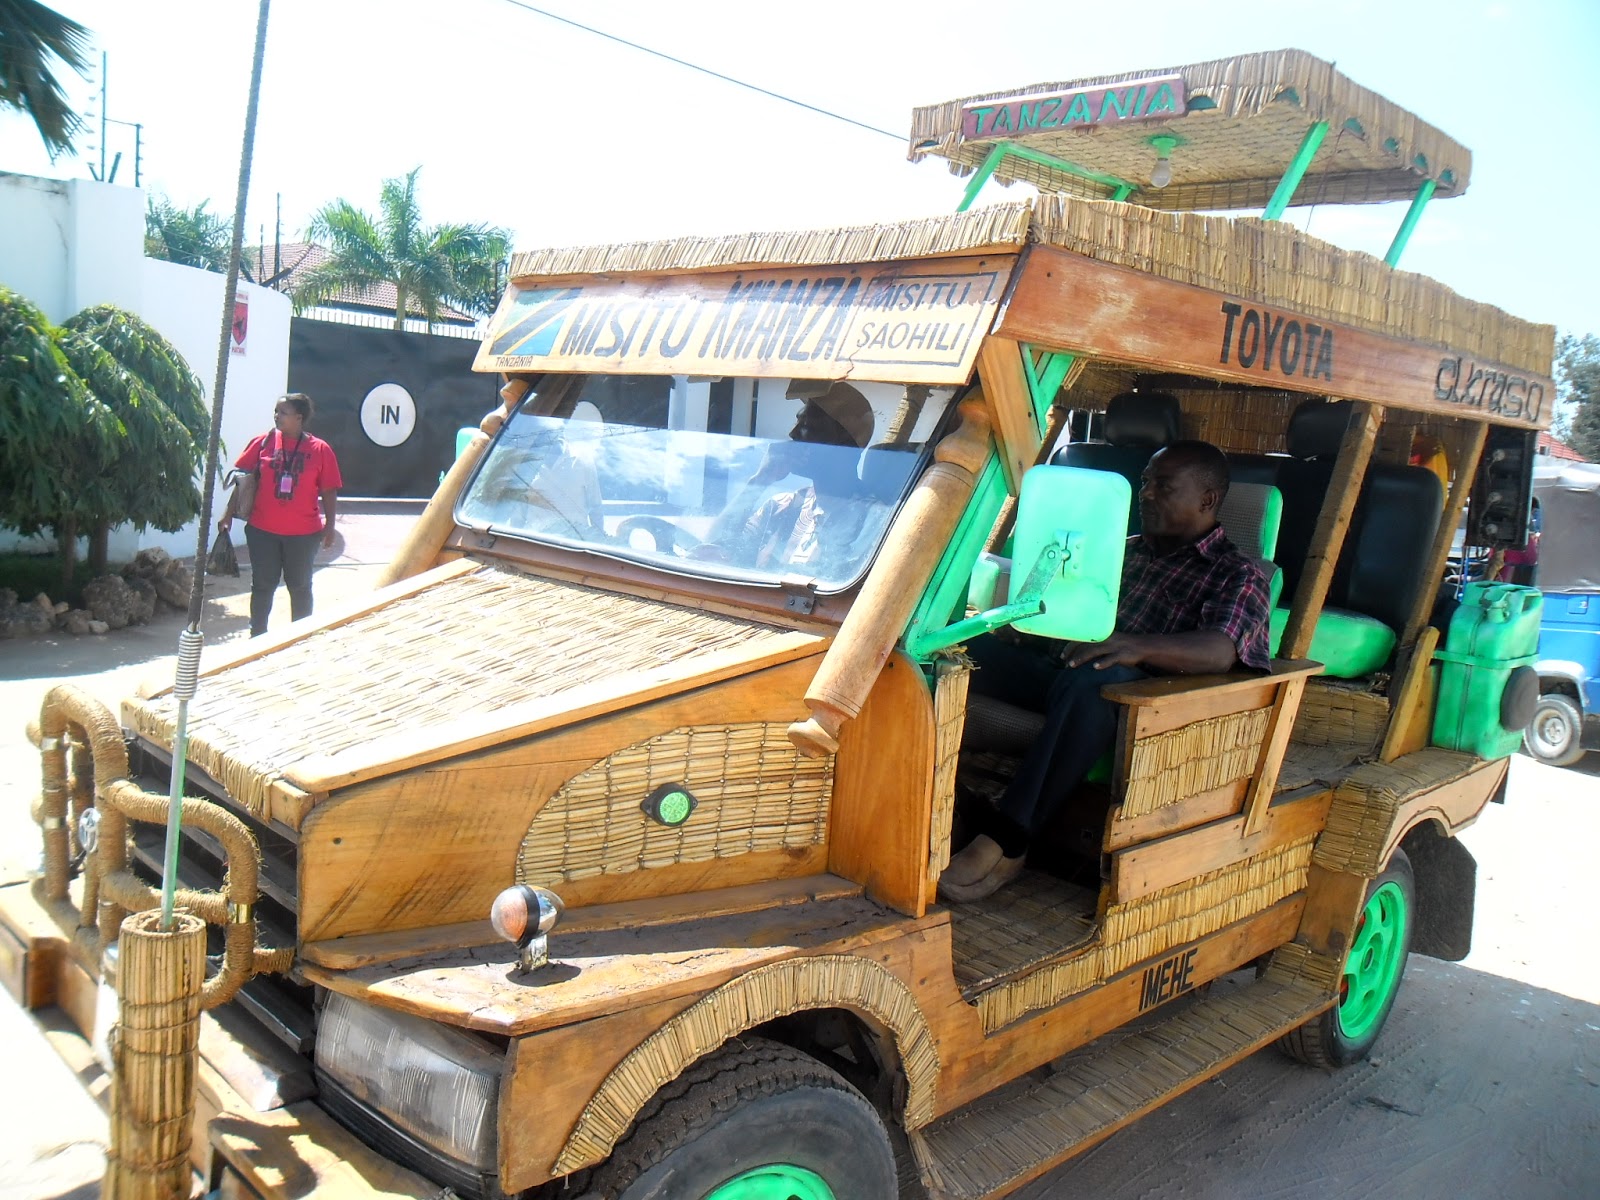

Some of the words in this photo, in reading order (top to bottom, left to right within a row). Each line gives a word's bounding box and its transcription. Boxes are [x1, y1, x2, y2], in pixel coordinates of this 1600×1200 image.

[969, 83, 1176, 135] TANZANIA
[863, 281, 971, 313] MISITU
[559, 297, 710, 359] MISITU
[697, 276, 862, 361] KWANZA
[856, 321, 966, 351] SAOHILI
[1219, 301, 1334, 383] TOYOTA
[495, 355, 534, 368] TANZANIA
[380, 404, 401, 425] IN
